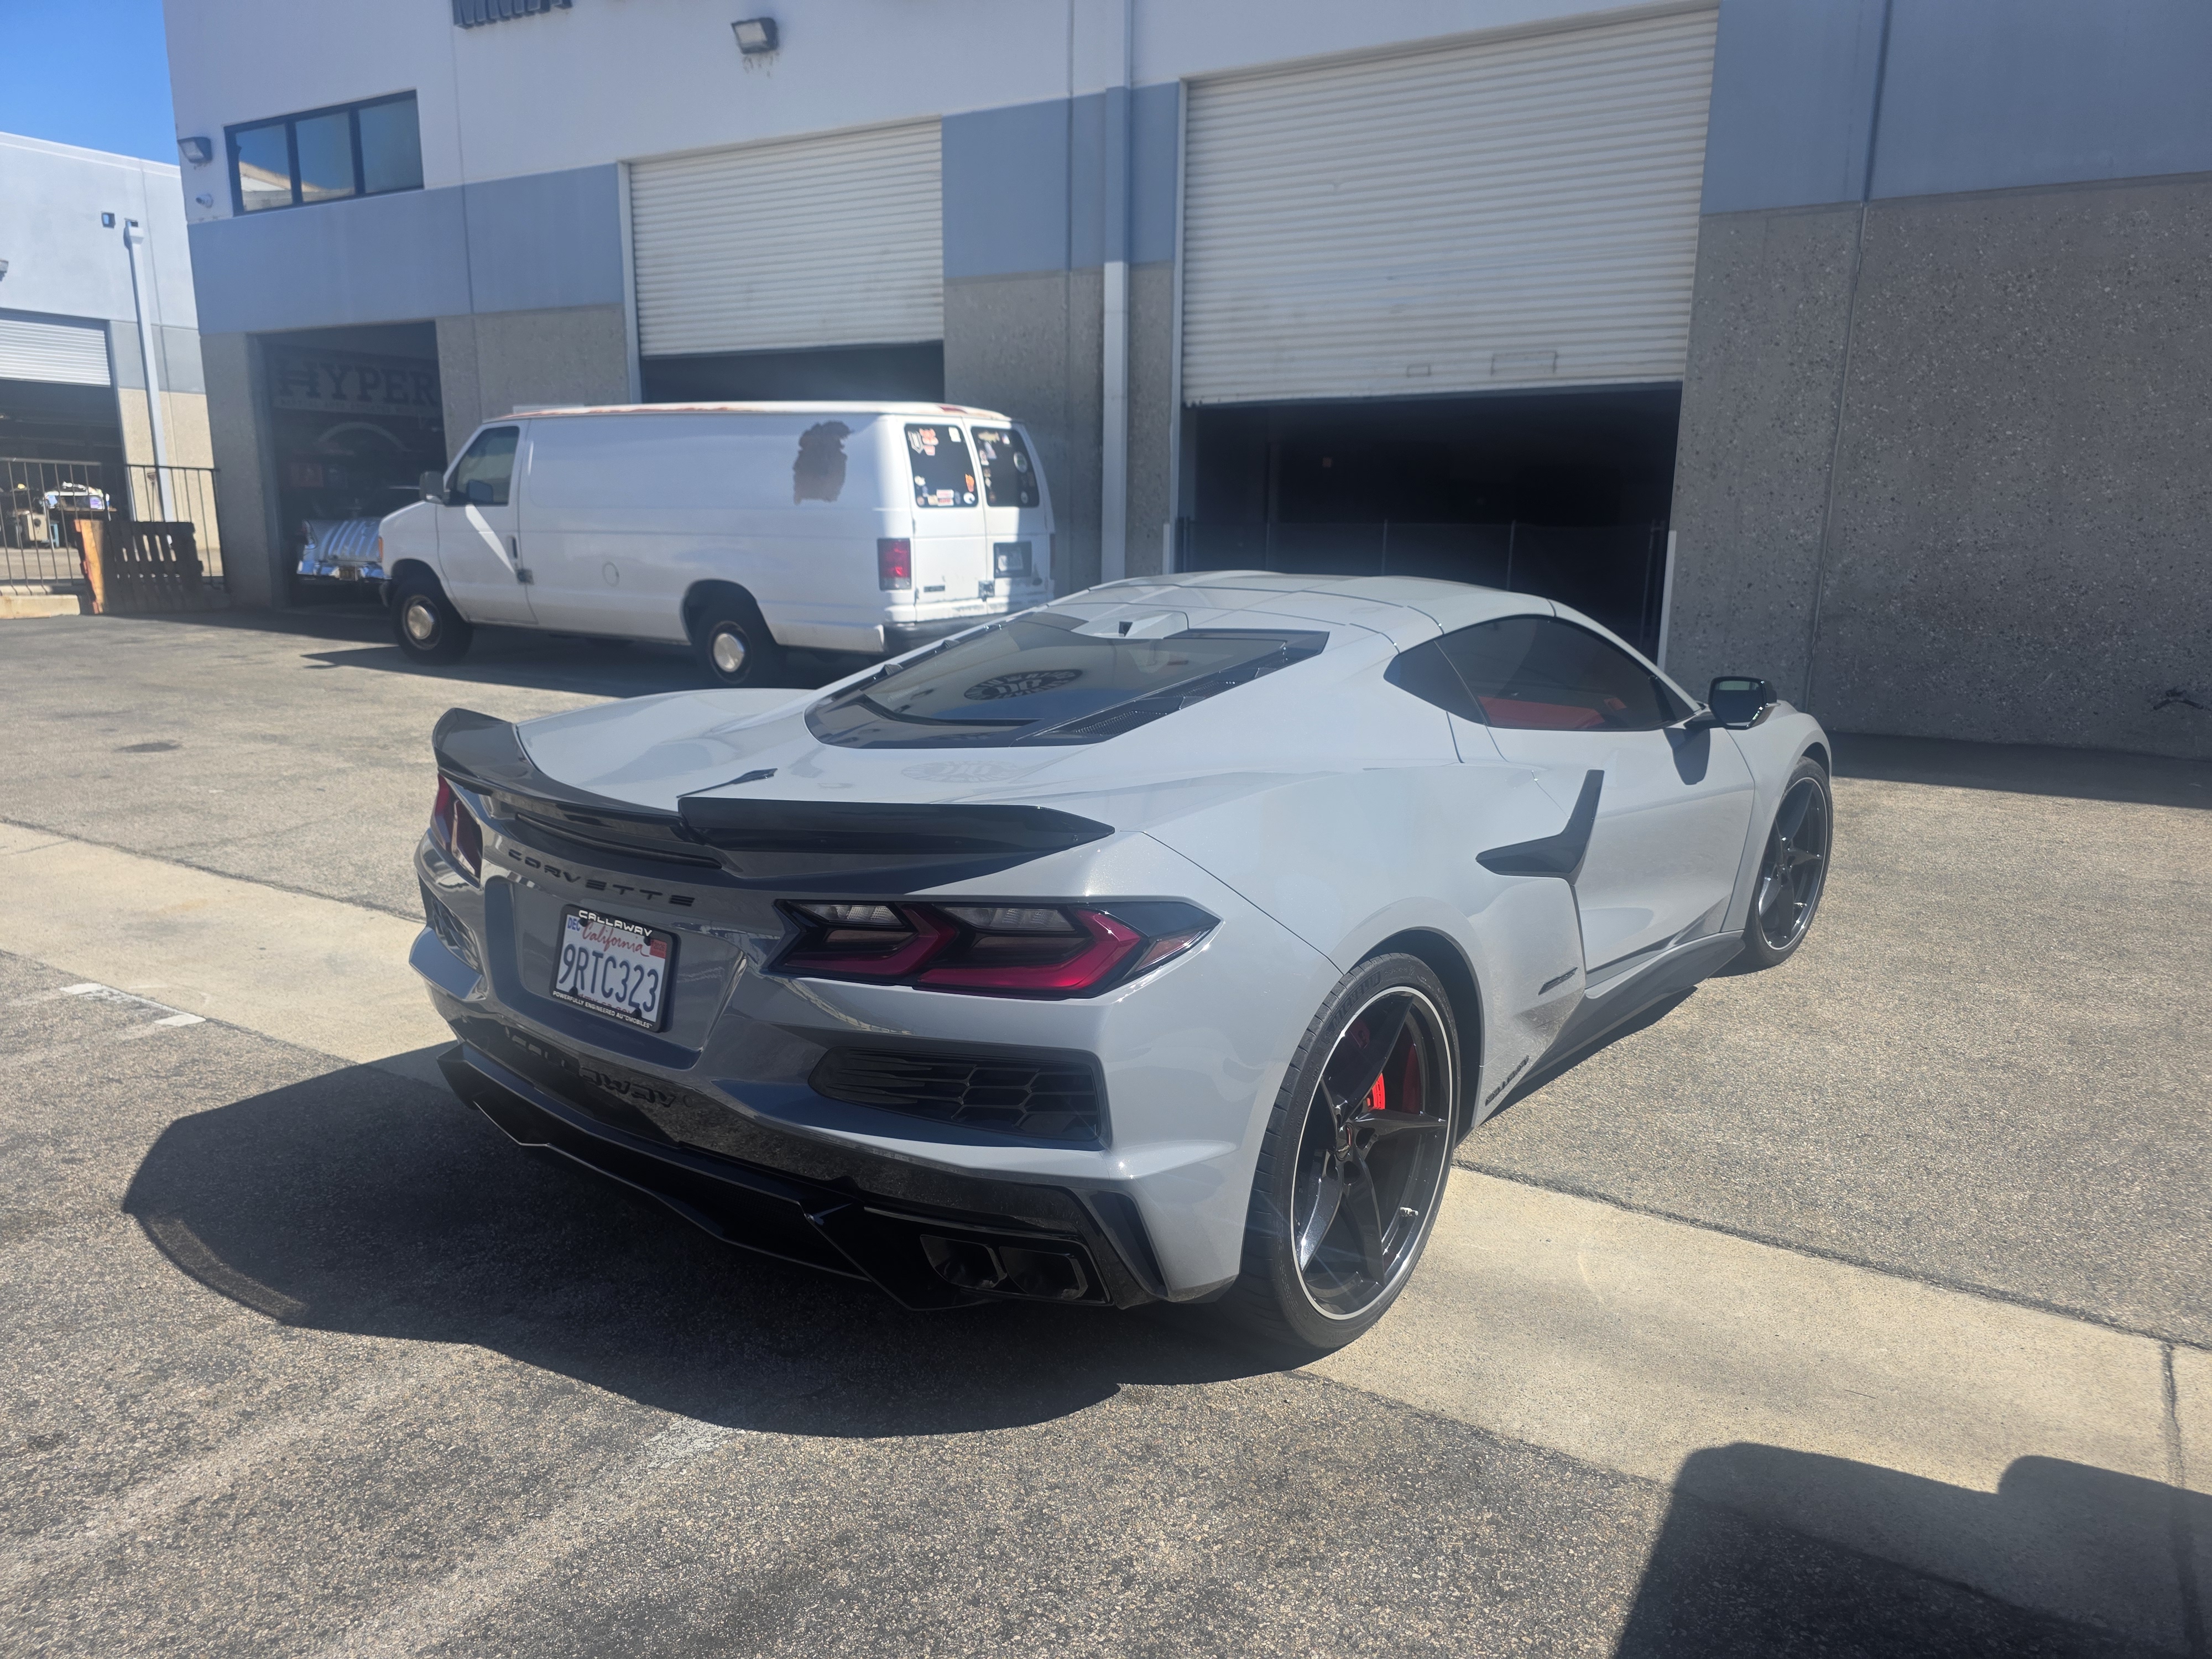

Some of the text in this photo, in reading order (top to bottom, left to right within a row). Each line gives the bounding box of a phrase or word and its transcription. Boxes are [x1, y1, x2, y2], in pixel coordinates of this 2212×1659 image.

[508, 848, 696, 907] CORVETTE
[567, 917, 581, 932] DEC
[578, 910, 653, 936] CALLAWAY
[582, 921, 650, 957] California
[559, 943, 659, 1012] 9RTC323
[552, 990, 585, 1006] POWERFULLY
[585, 1001, 615, 1016] ENGINEERED
[1332, 972, 1381, 1030] MICHELIN
